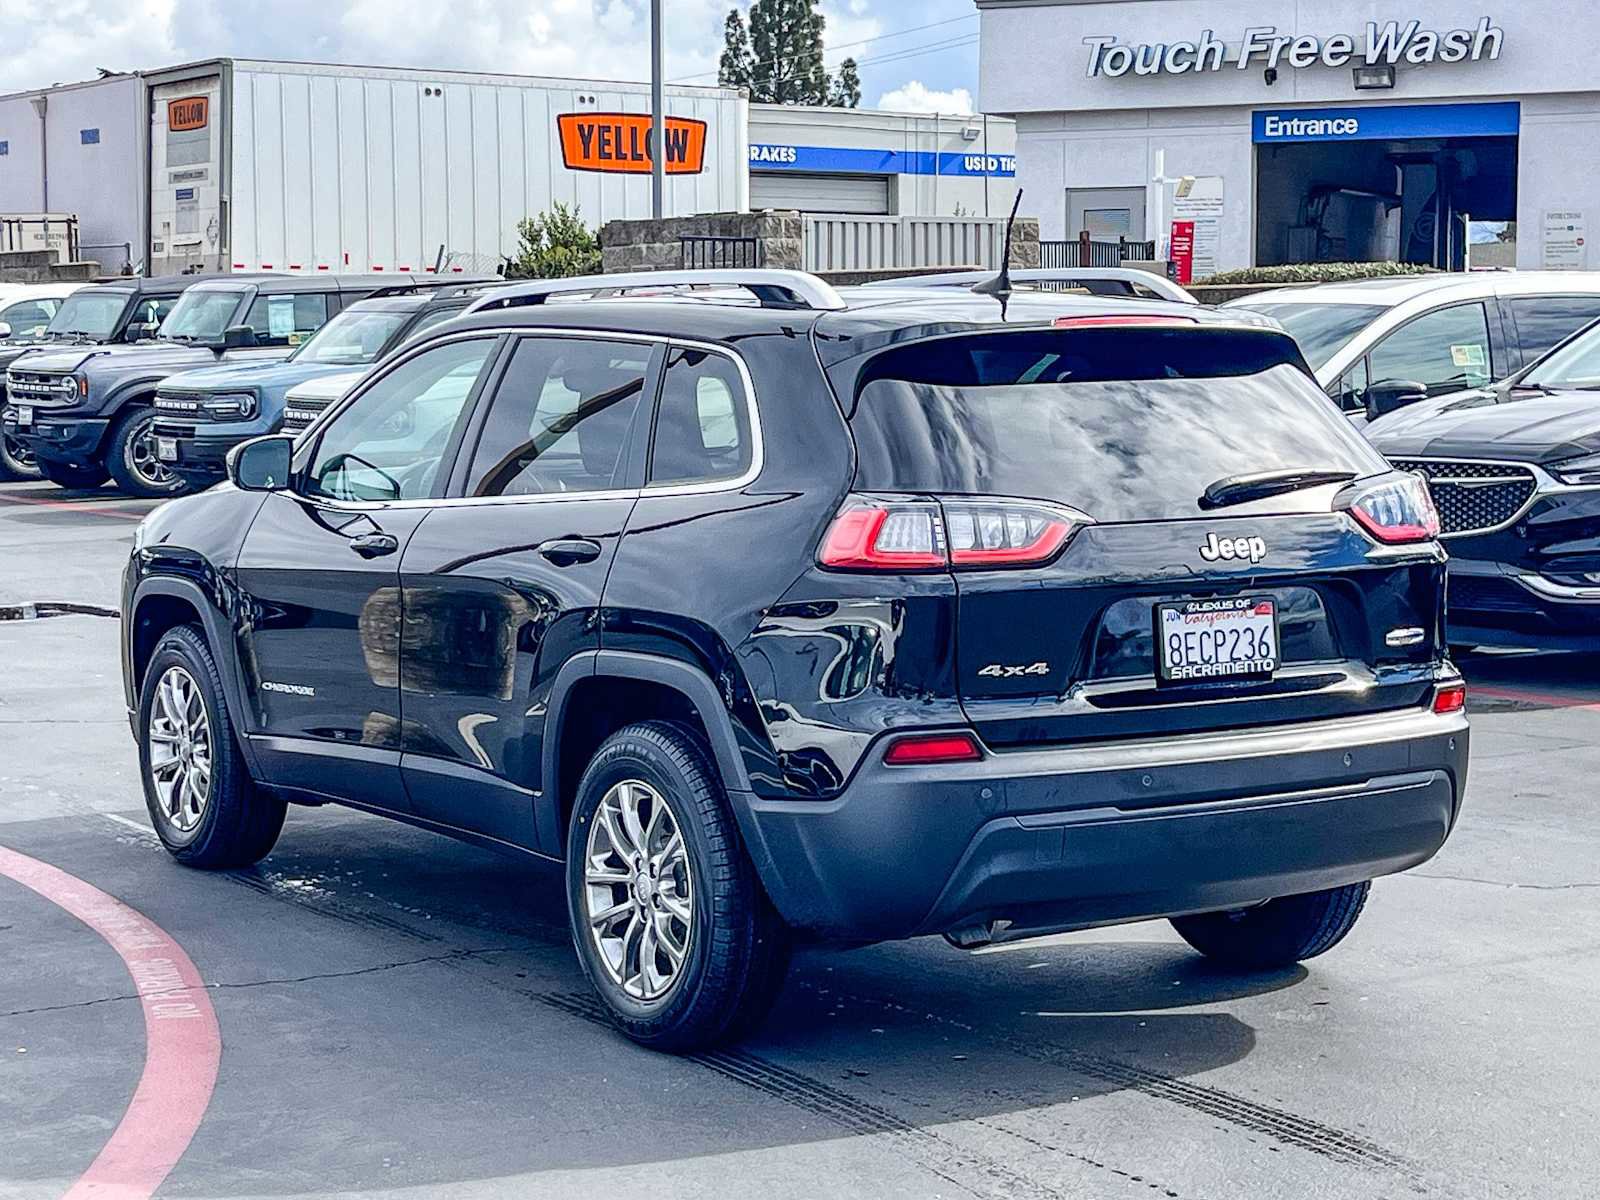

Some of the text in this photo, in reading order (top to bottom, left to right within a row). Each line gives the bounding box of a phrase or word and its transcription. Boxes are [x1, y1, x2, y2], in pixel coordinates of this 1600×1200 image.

[1082, 16, 1505, 78] Touch Free Wash
[1265, 116, 1359, 137] Entrance
[1199, 531, 1267, 564] Jeep
[1196, 598, 1251, 611] LEXUS OF
[1168, 624, 1271, 667] 8ECP236
[978, 662, 1050, 678] 4x4
[1170, 658, 1275, 680] SACRAMENTO
[127, 957, 194, 1001] PARKING
[151, 1001, 204, 1020] NO
